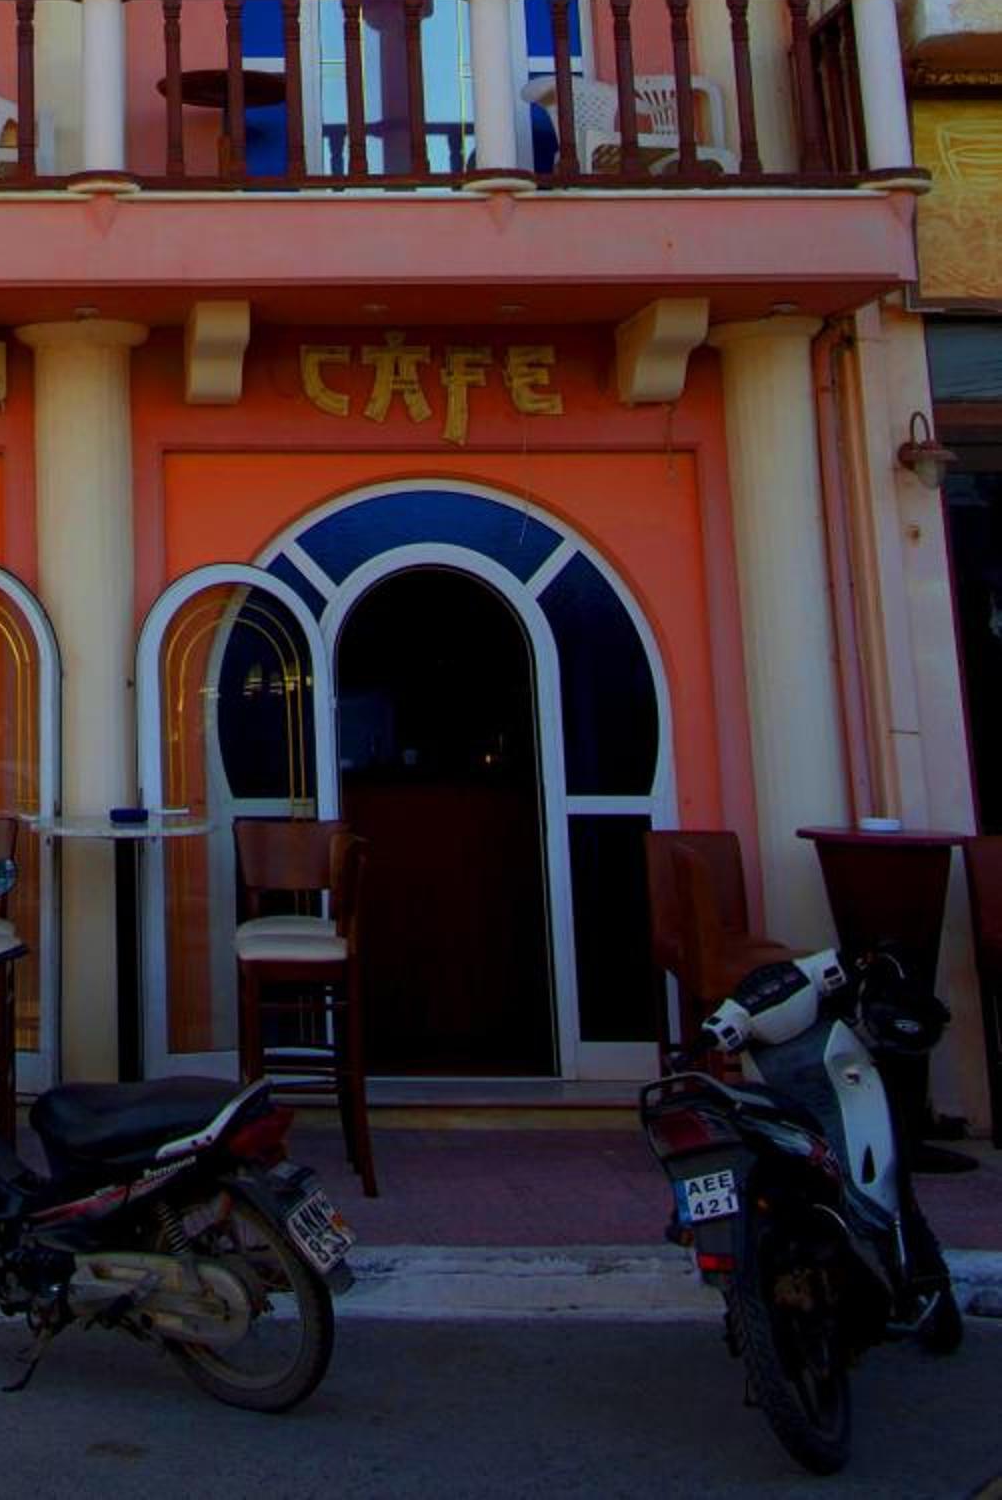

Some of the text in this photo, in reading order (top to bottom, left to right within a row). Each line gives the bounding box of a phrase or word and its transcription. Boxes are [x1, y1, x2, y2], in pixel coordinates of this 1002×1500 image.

[299, 329, 566, 447] CAFE
[688, 1172, 732, 1196] AEE
[695, 1196, 733, 1216] 421
